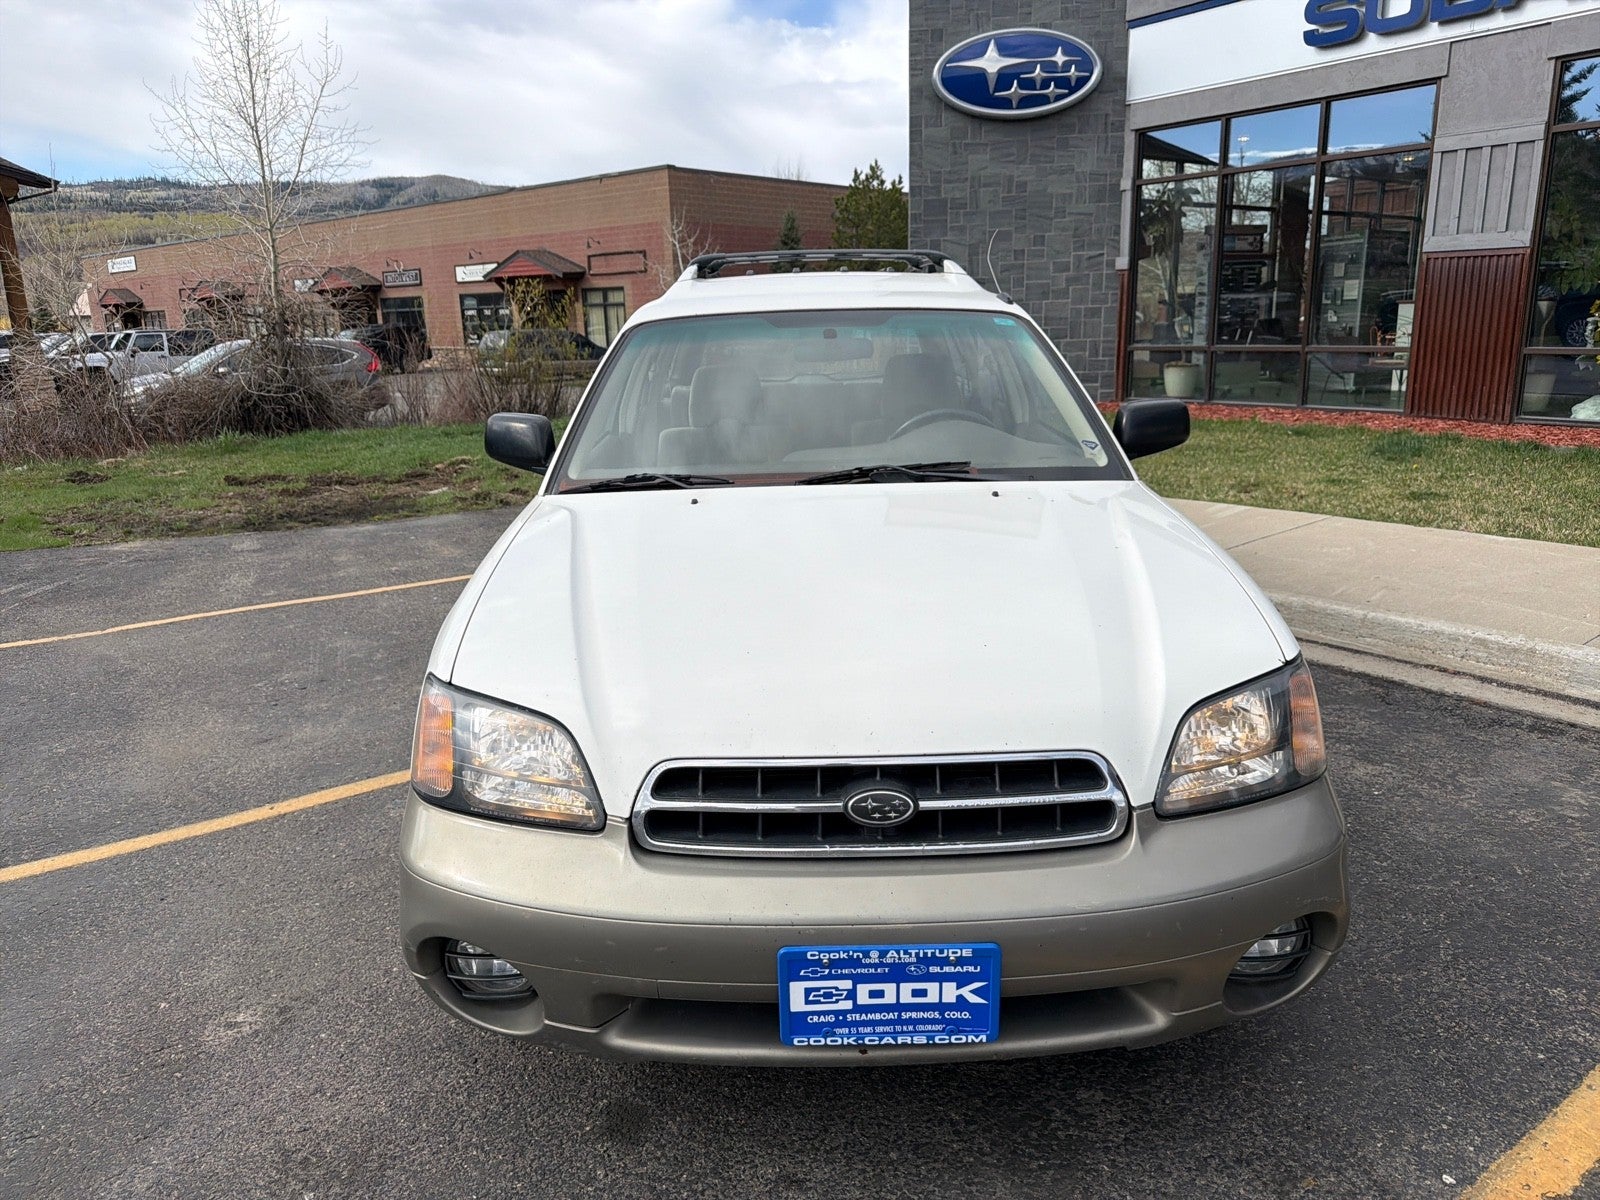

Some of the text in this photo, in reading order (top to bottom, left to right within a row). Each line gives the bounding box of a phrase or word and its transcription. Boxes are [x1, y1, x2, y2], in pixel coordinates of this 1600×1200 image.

[806, 950, 863, 960] Cook'n
[886, 948, 973, 958] ALTITUDE
[861, 956, 917, 964] cook-cars.com
[831, 967, 890, 975] CHEVROLET
[928, 965, 981, 973] SUBARU
[807, 1011, 972, 1024] CRAIG STEAMBOAT SPRINGS, COLO.
[858, 1026, 874, 1034] YEARS
[874, 1025, 893, 1034] SERVICE
[793, 1034, 987, 1046] COOK-CARS.COM
